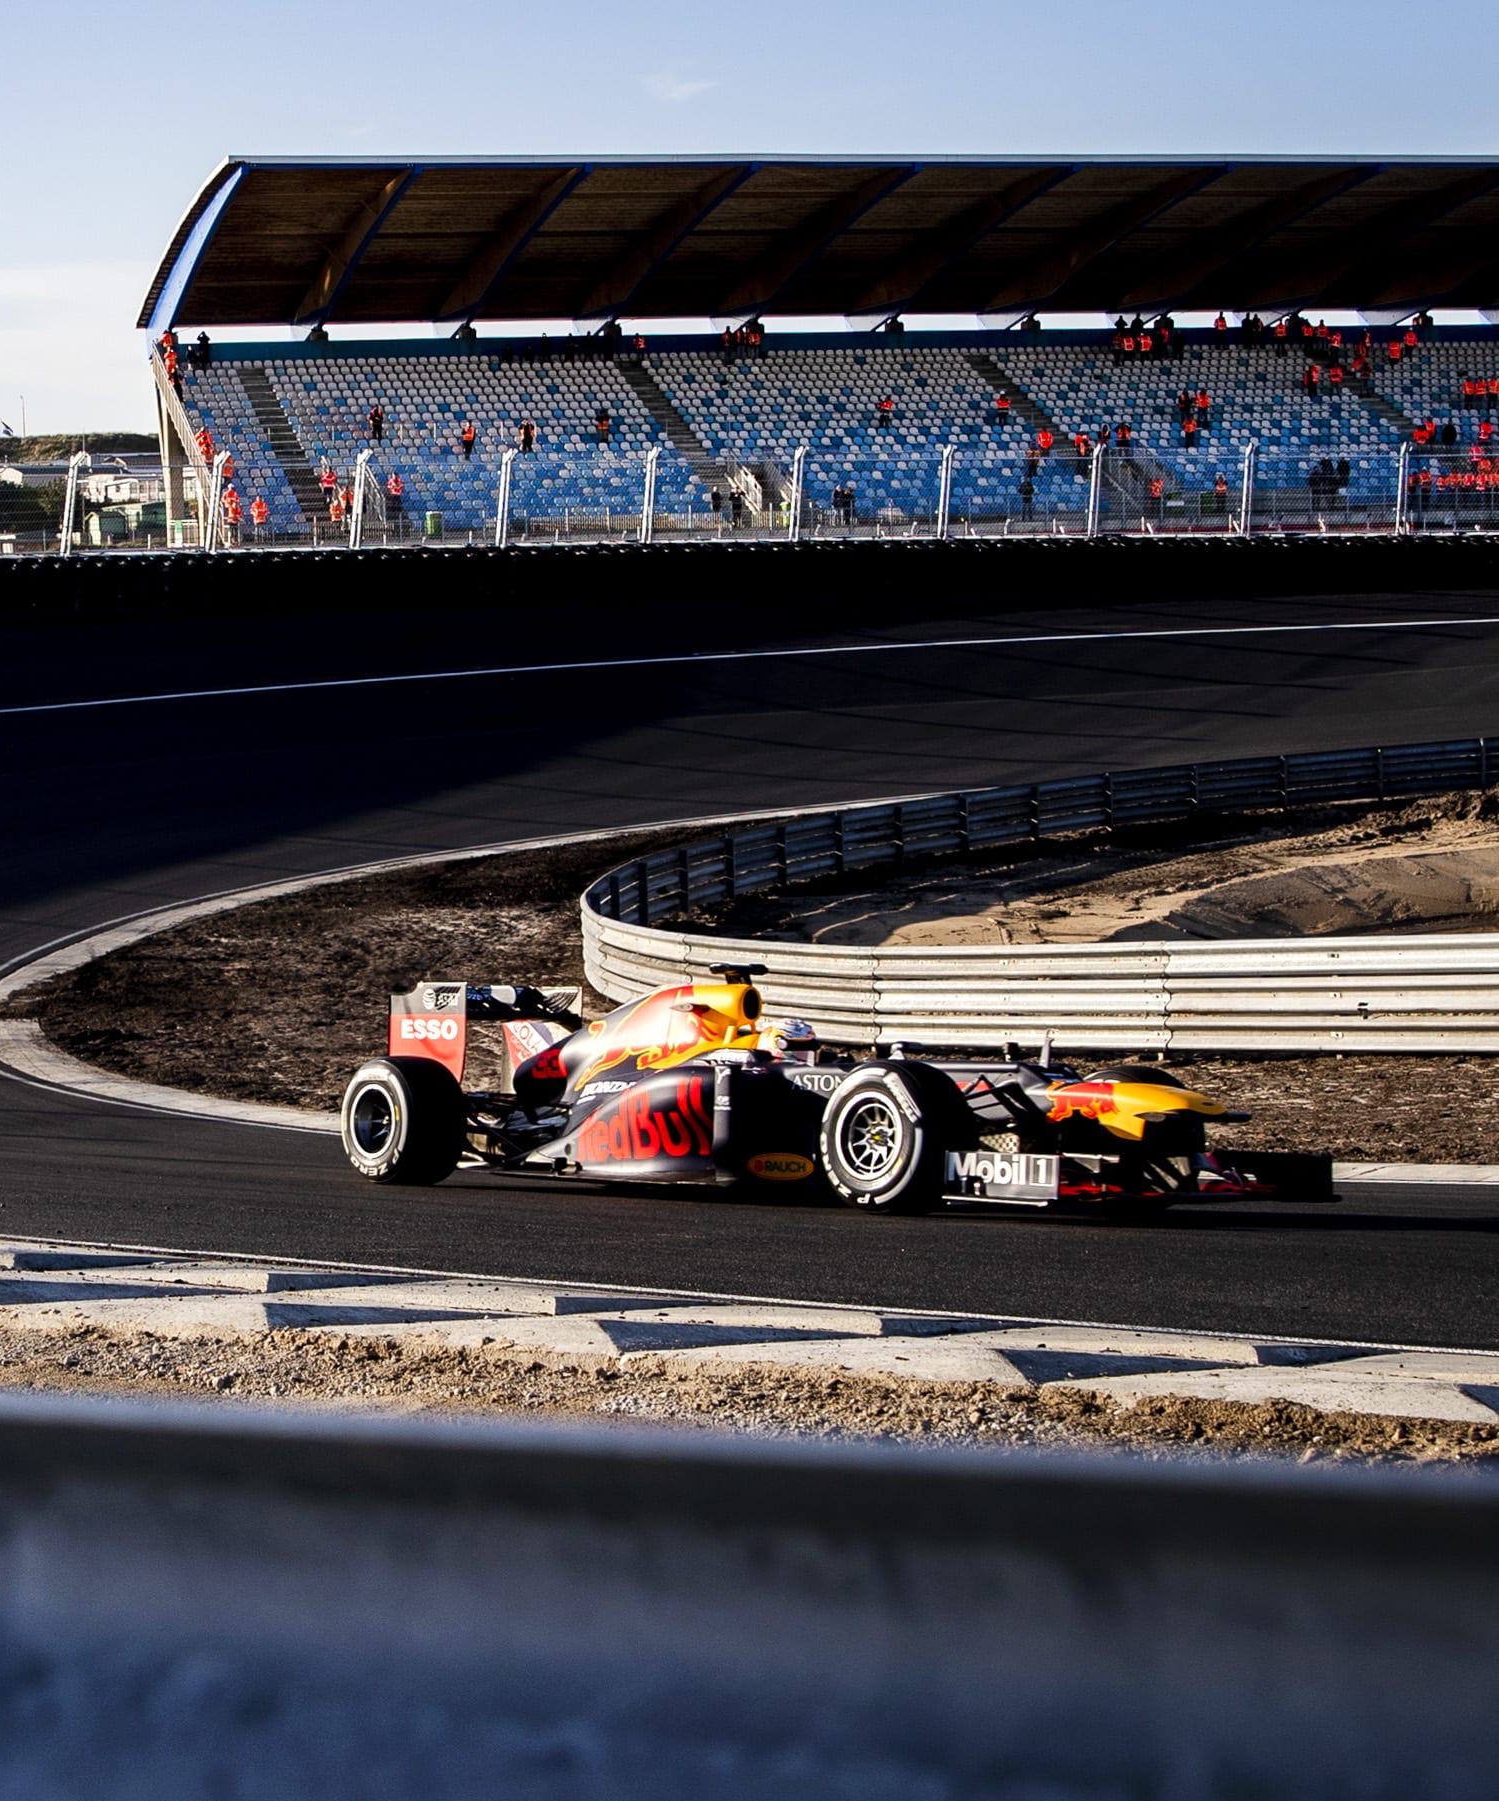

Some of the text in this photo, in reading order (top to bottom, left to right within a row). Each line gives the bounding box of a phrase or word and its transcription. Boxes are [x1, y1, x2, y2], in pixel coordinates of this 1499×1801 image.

[401, 1019, 458, 1041] ESSO
[631, 1077, 715, 1161] Bull
[350, 1155, 389, 1176] ZERO
[765, 1160, 806, 1173] RAUCH
[948, 1152, 1047, 1185] Mobil 1
